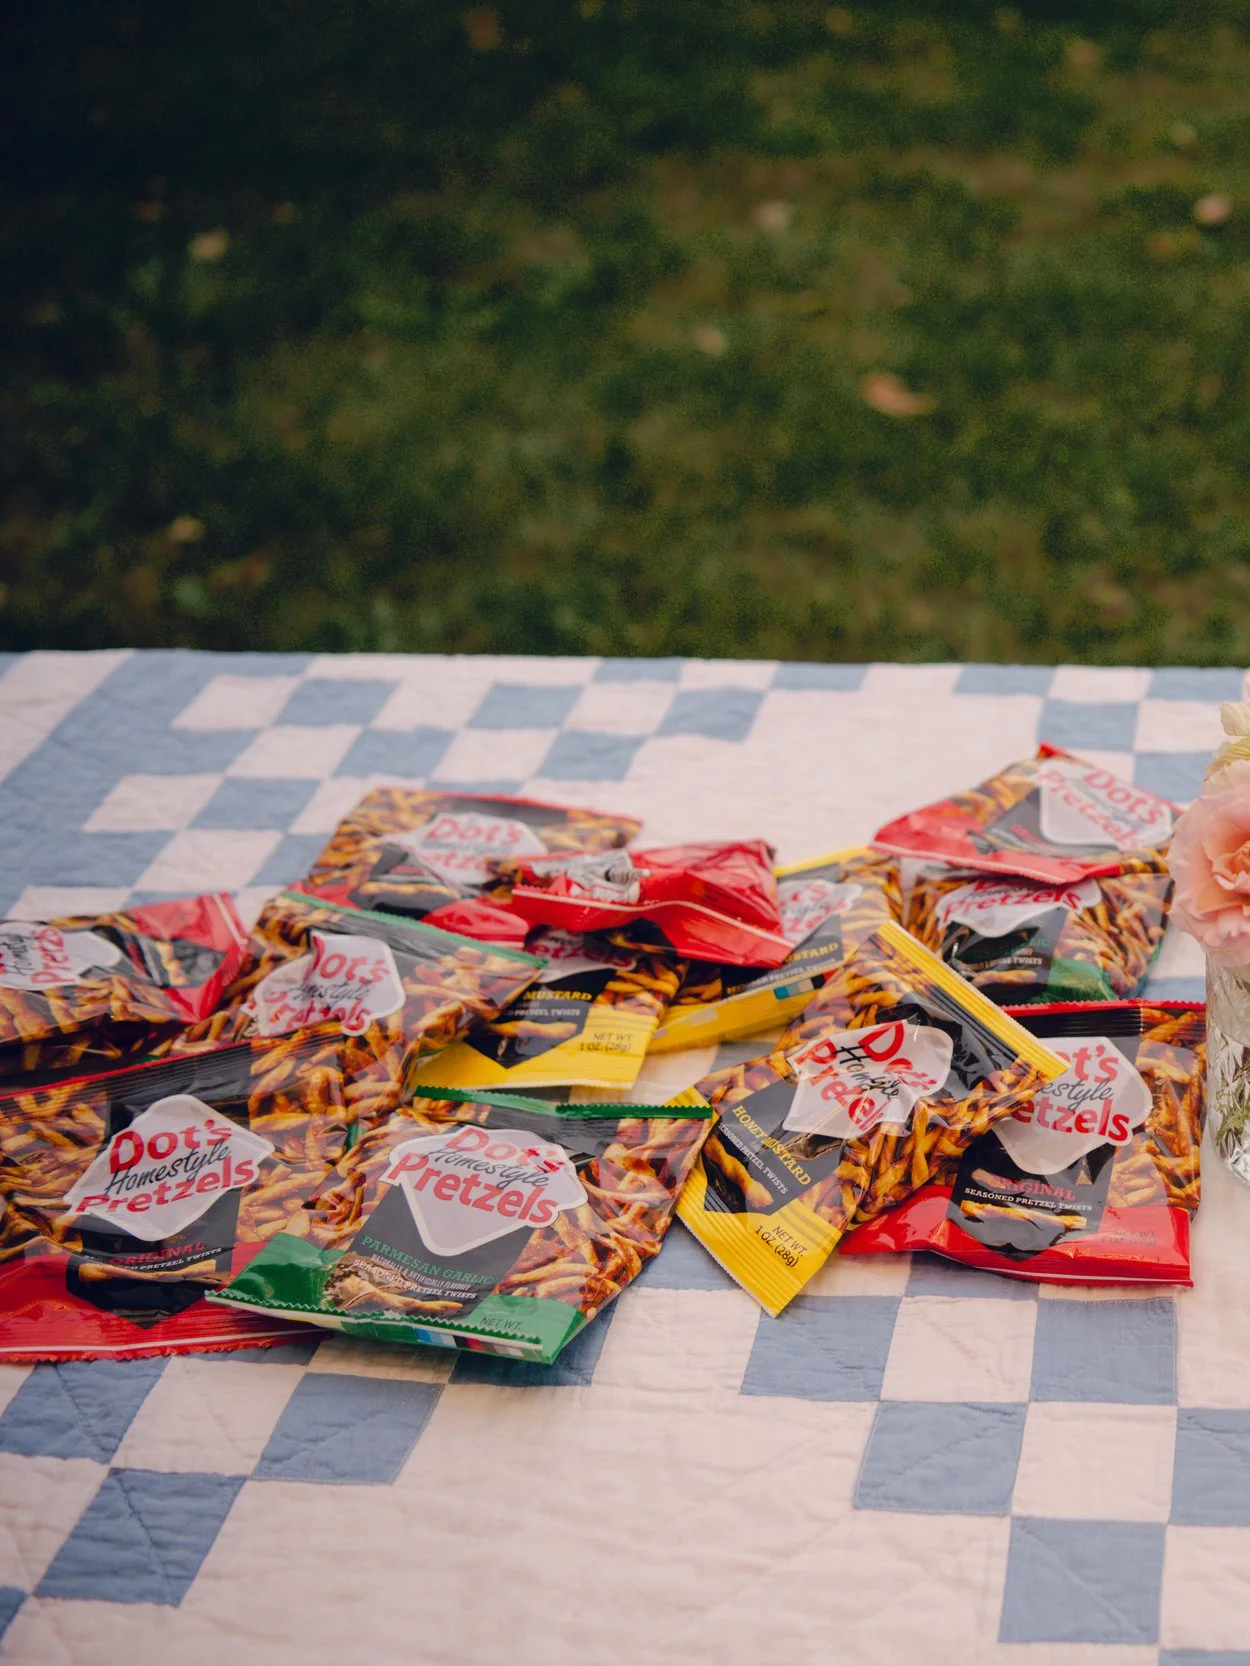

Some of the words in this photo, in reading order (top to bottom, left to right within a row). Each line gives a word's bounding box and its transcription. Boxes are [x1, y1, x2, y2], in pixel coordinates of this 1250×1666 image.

[592, 1032, 613, 1042] NET
[1055, 1044, 1120, 1084] t's
[1040, 1078, 1115, 1112] estyle
[1010, 1096, 1130, 1142] etzels
[109, 1119, 232, 1174] Dot's
[444, 1127, 565, 1174] Dot's
[732, 1104, 768, 1144] HONEY
[763, 1136, 812, 1186] MUSTARD
[75, 1155, 255, 1213] Pretzels
[104, 1139, 231, 1196] Homestyle
[388, 1152, 558, 1224] Pretzels
[423, 1147, 551, 1190] Homestyle
[740, 1144, 765, 1170] PRETZEL
[763, 1167, 789, 1196] TWISTS
[988, 1174, 1076, 1201] ORIGINAL
[964, 1187, 1014, 1202] SEASONED
[1015, 1196, 1057, 1209] PRETZEL
[1058, 1201, 1093, 1212] TWISTS
[108, 1239, 206, 1265] ORIGINAL
[754, 1225, 762, 1235] 1
[761, 1231, 775, 1249] OZ.
[774, 1243, 800, 1268] (28g)
[772, 1225, 791, 1243] NET
[139, 1258, 184, 1272] PRETZEL
[185, 1247, 223, 1263] TWISTS
[361, 1235, 441, 1278] PARMESAN
[442, 1269, 495, 1285] GARLIC
[404, 1280, 443, 1297] PRETZEL
[443, 1289, 478, 1300] TWISTS
[480, 1315, 502, 1327] NET
